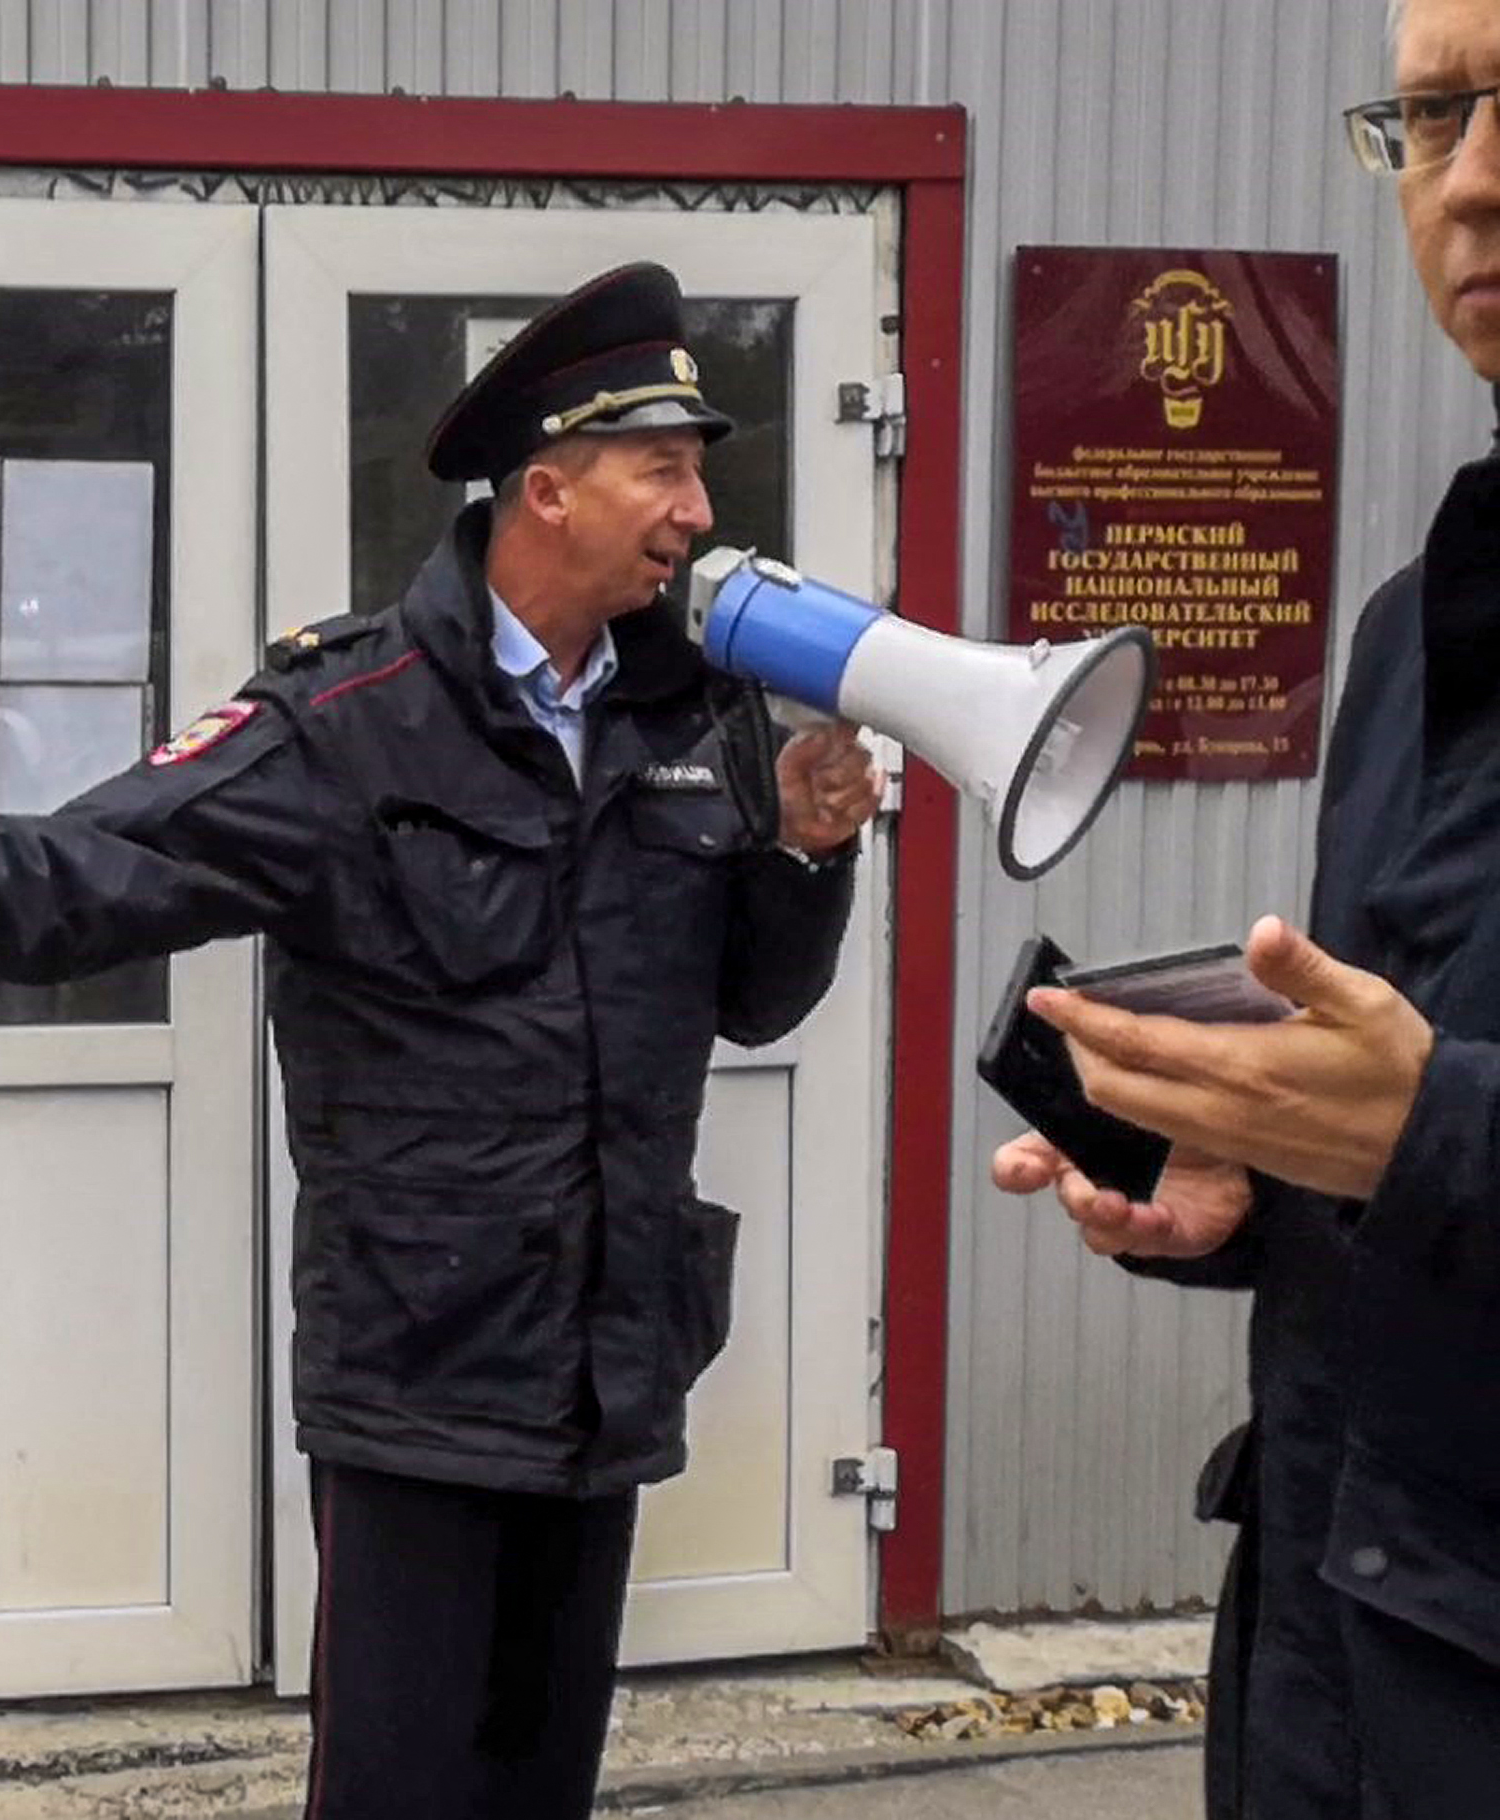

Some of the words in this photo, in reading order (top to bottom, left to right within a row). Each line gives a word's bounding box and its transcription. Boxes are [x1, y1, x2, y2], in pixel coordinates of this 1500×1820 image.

[1105, 522, 1246, 545] ПЕРМСКИЙ
[1048, 548, 1299, 573] ГОСУДАРСТВЕННЫЙ
[1065, 575, 1280, 598] НАЦИОНАЛЬНЫЙ
[1030, 600, 1313, 624] ИССЛЕДОВАТЕЛЬСКИЙ
[1083, 628, 1260, 649] ЕРСИТЕТ
